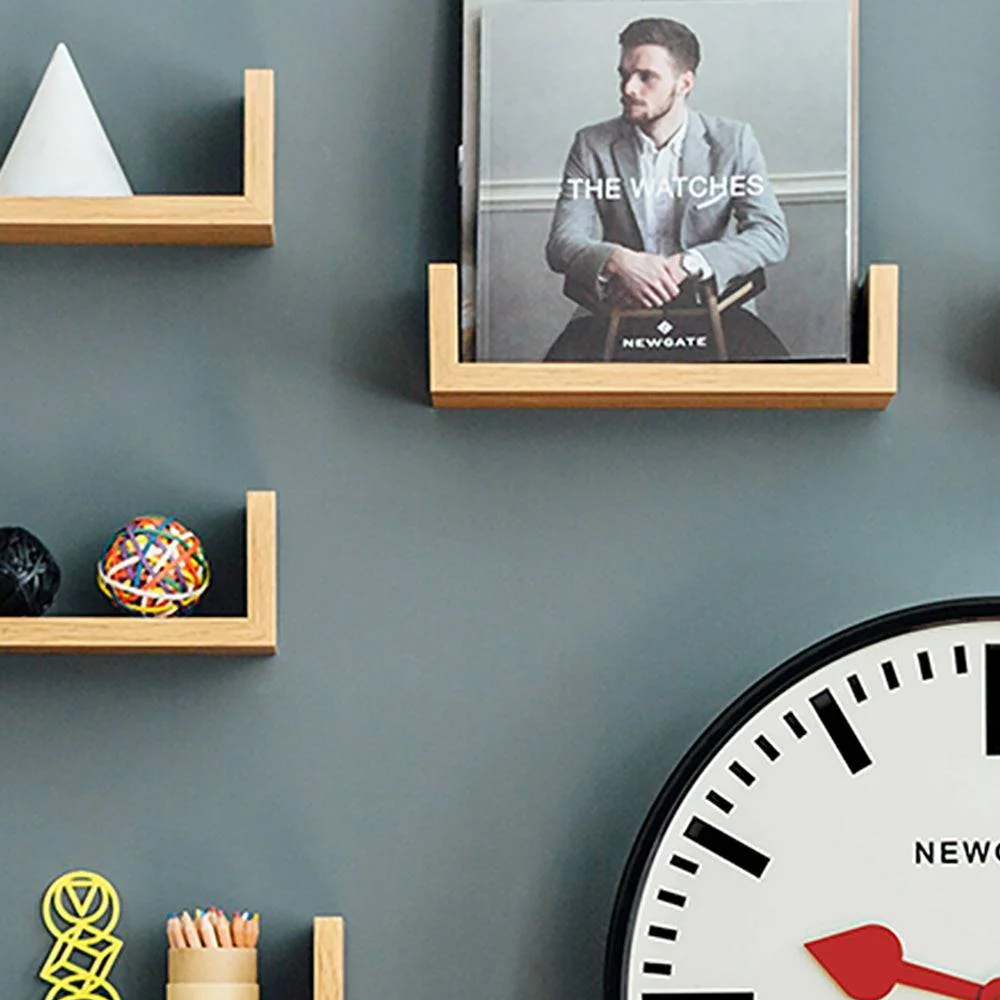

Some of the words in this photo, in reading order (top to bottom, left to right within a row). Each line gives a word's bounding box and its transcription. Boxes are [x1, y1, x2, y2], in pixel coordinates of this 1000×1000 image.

[567, 178, 621, 199] THE
[630, 175, 765, 199] WATCHES
[622, 336, 707, 348] NEWGATE
